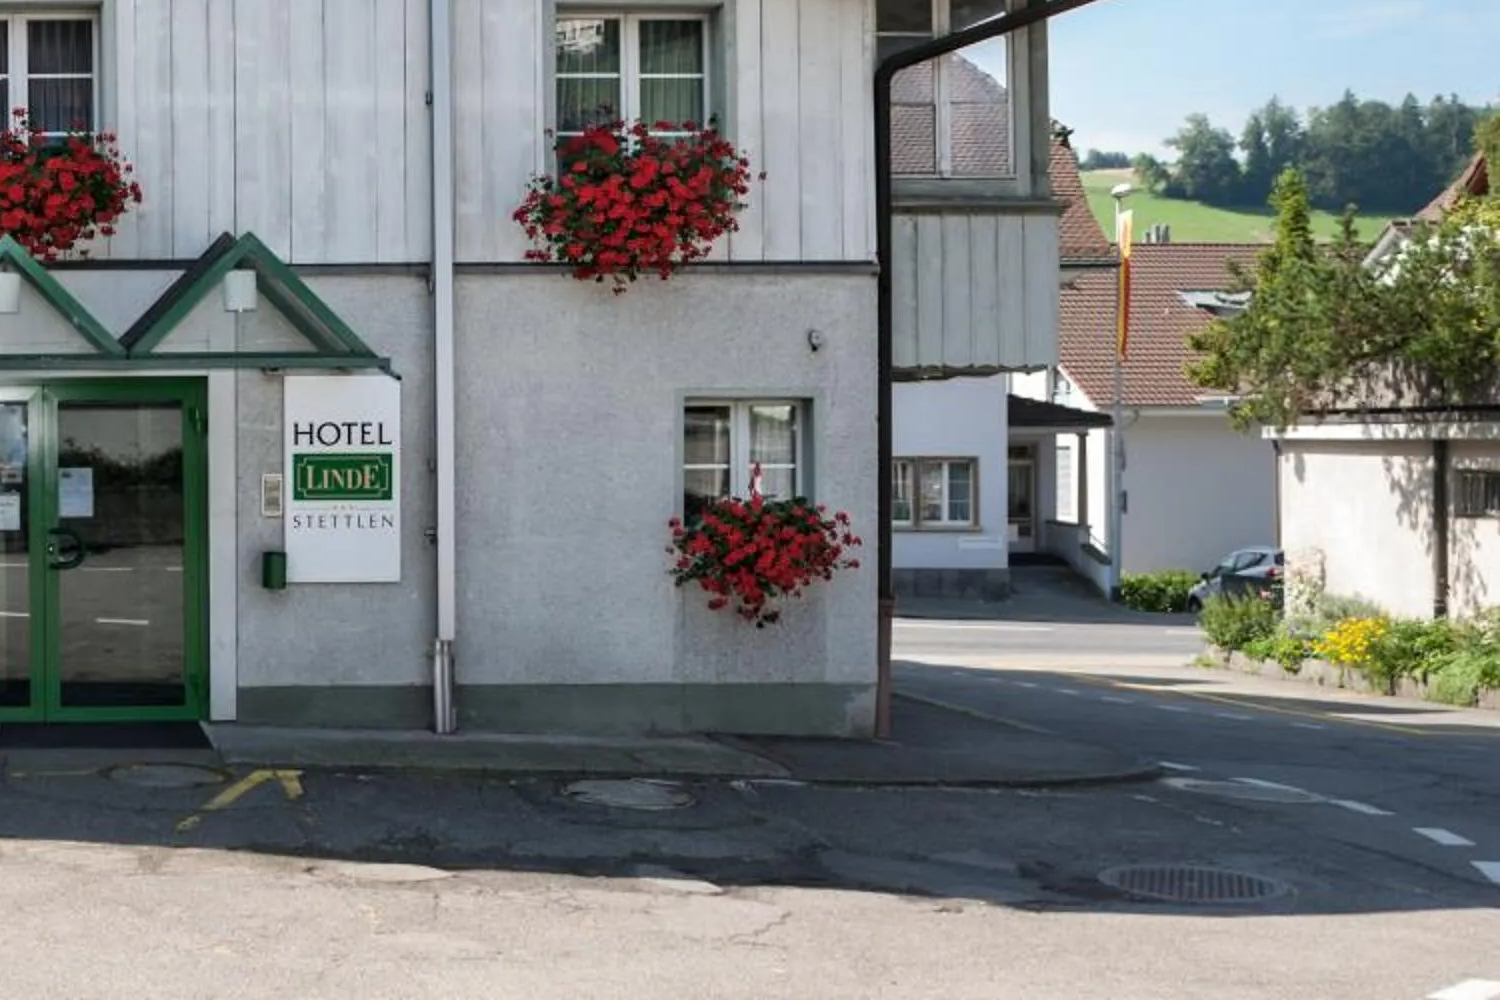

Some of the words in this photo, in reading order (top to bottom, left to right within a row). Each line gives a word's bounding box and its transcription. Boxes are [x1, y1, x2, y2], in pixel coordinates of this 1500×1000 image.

[293, 422, 392, 446] HOTEL
[306, 464, 380, 490] LINDE
[293, 514, 394, 529] STETTLEN
